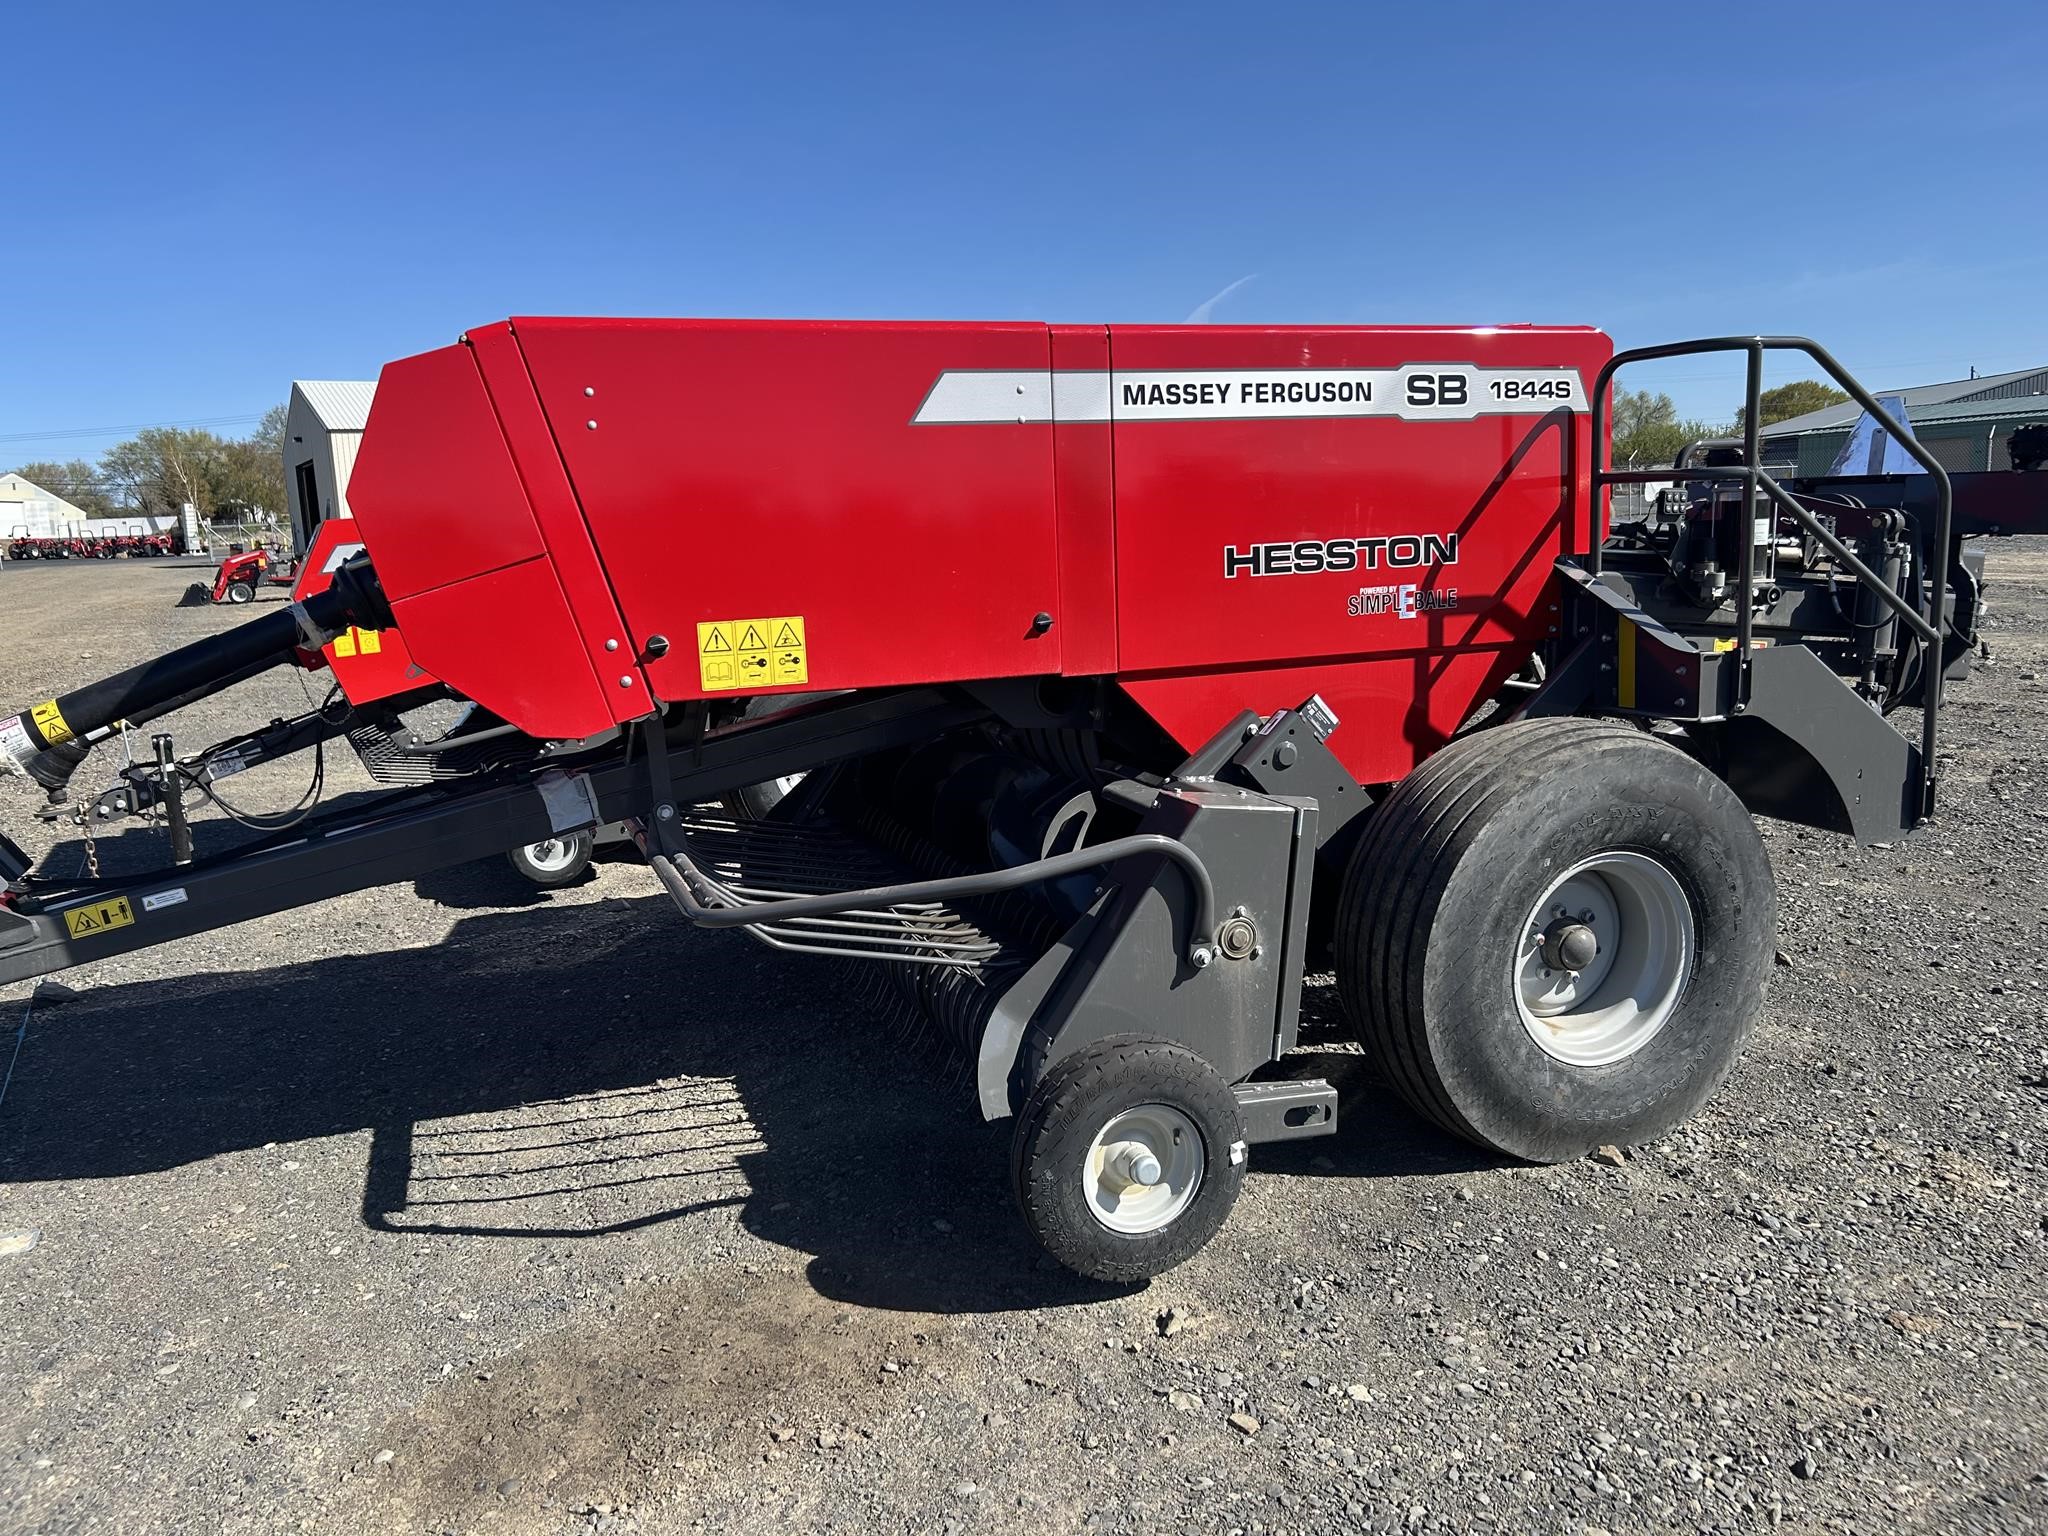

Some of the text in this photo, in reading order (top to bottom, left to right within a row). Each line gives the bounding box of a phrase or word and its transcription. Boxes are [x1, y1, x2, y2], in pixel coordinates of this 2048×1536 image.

[1122, 373, 1571, 407] MASSEY FERGUSON SB 1844S
[1224, 533, 1458, 579] HESSTON
[1359, 585, 1398, 595] POWERED BY
